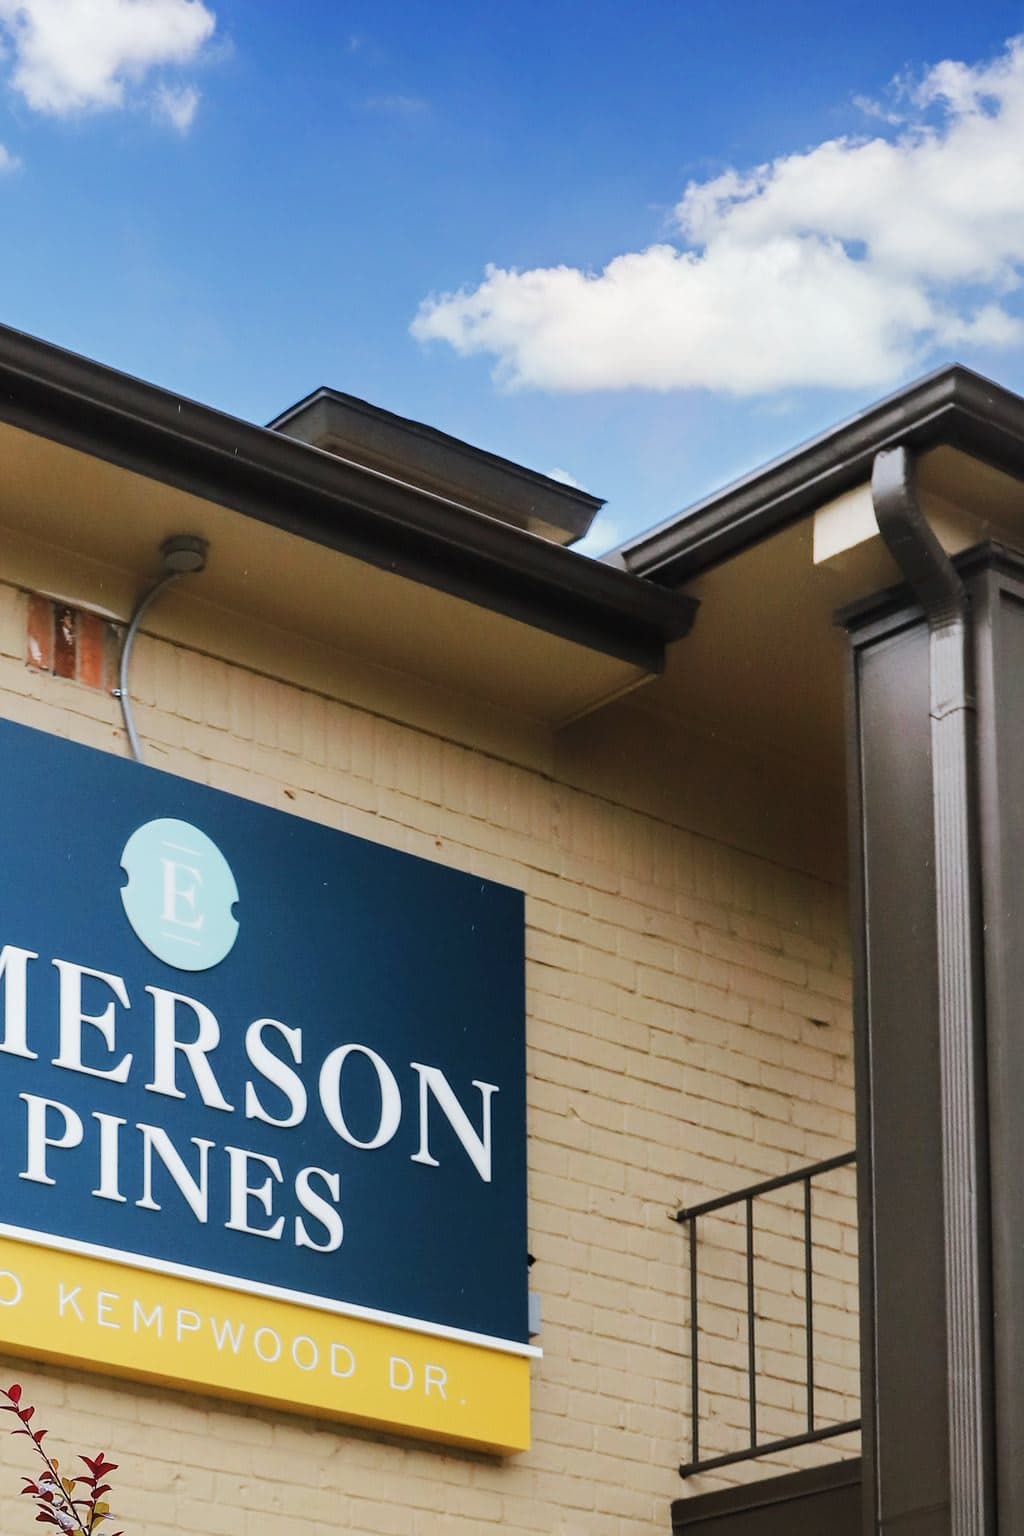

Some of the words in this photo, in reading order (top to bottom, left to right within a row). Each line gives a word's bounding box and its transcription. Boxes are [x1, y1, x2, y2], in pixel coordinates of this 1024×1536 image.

[160, 858, 204, 930] E
[18, 1092, 344, 1254] PINES
[58, 1283, 357, 1379] KEMPWOOD
[388, 1357, 467, 1403] DR.
